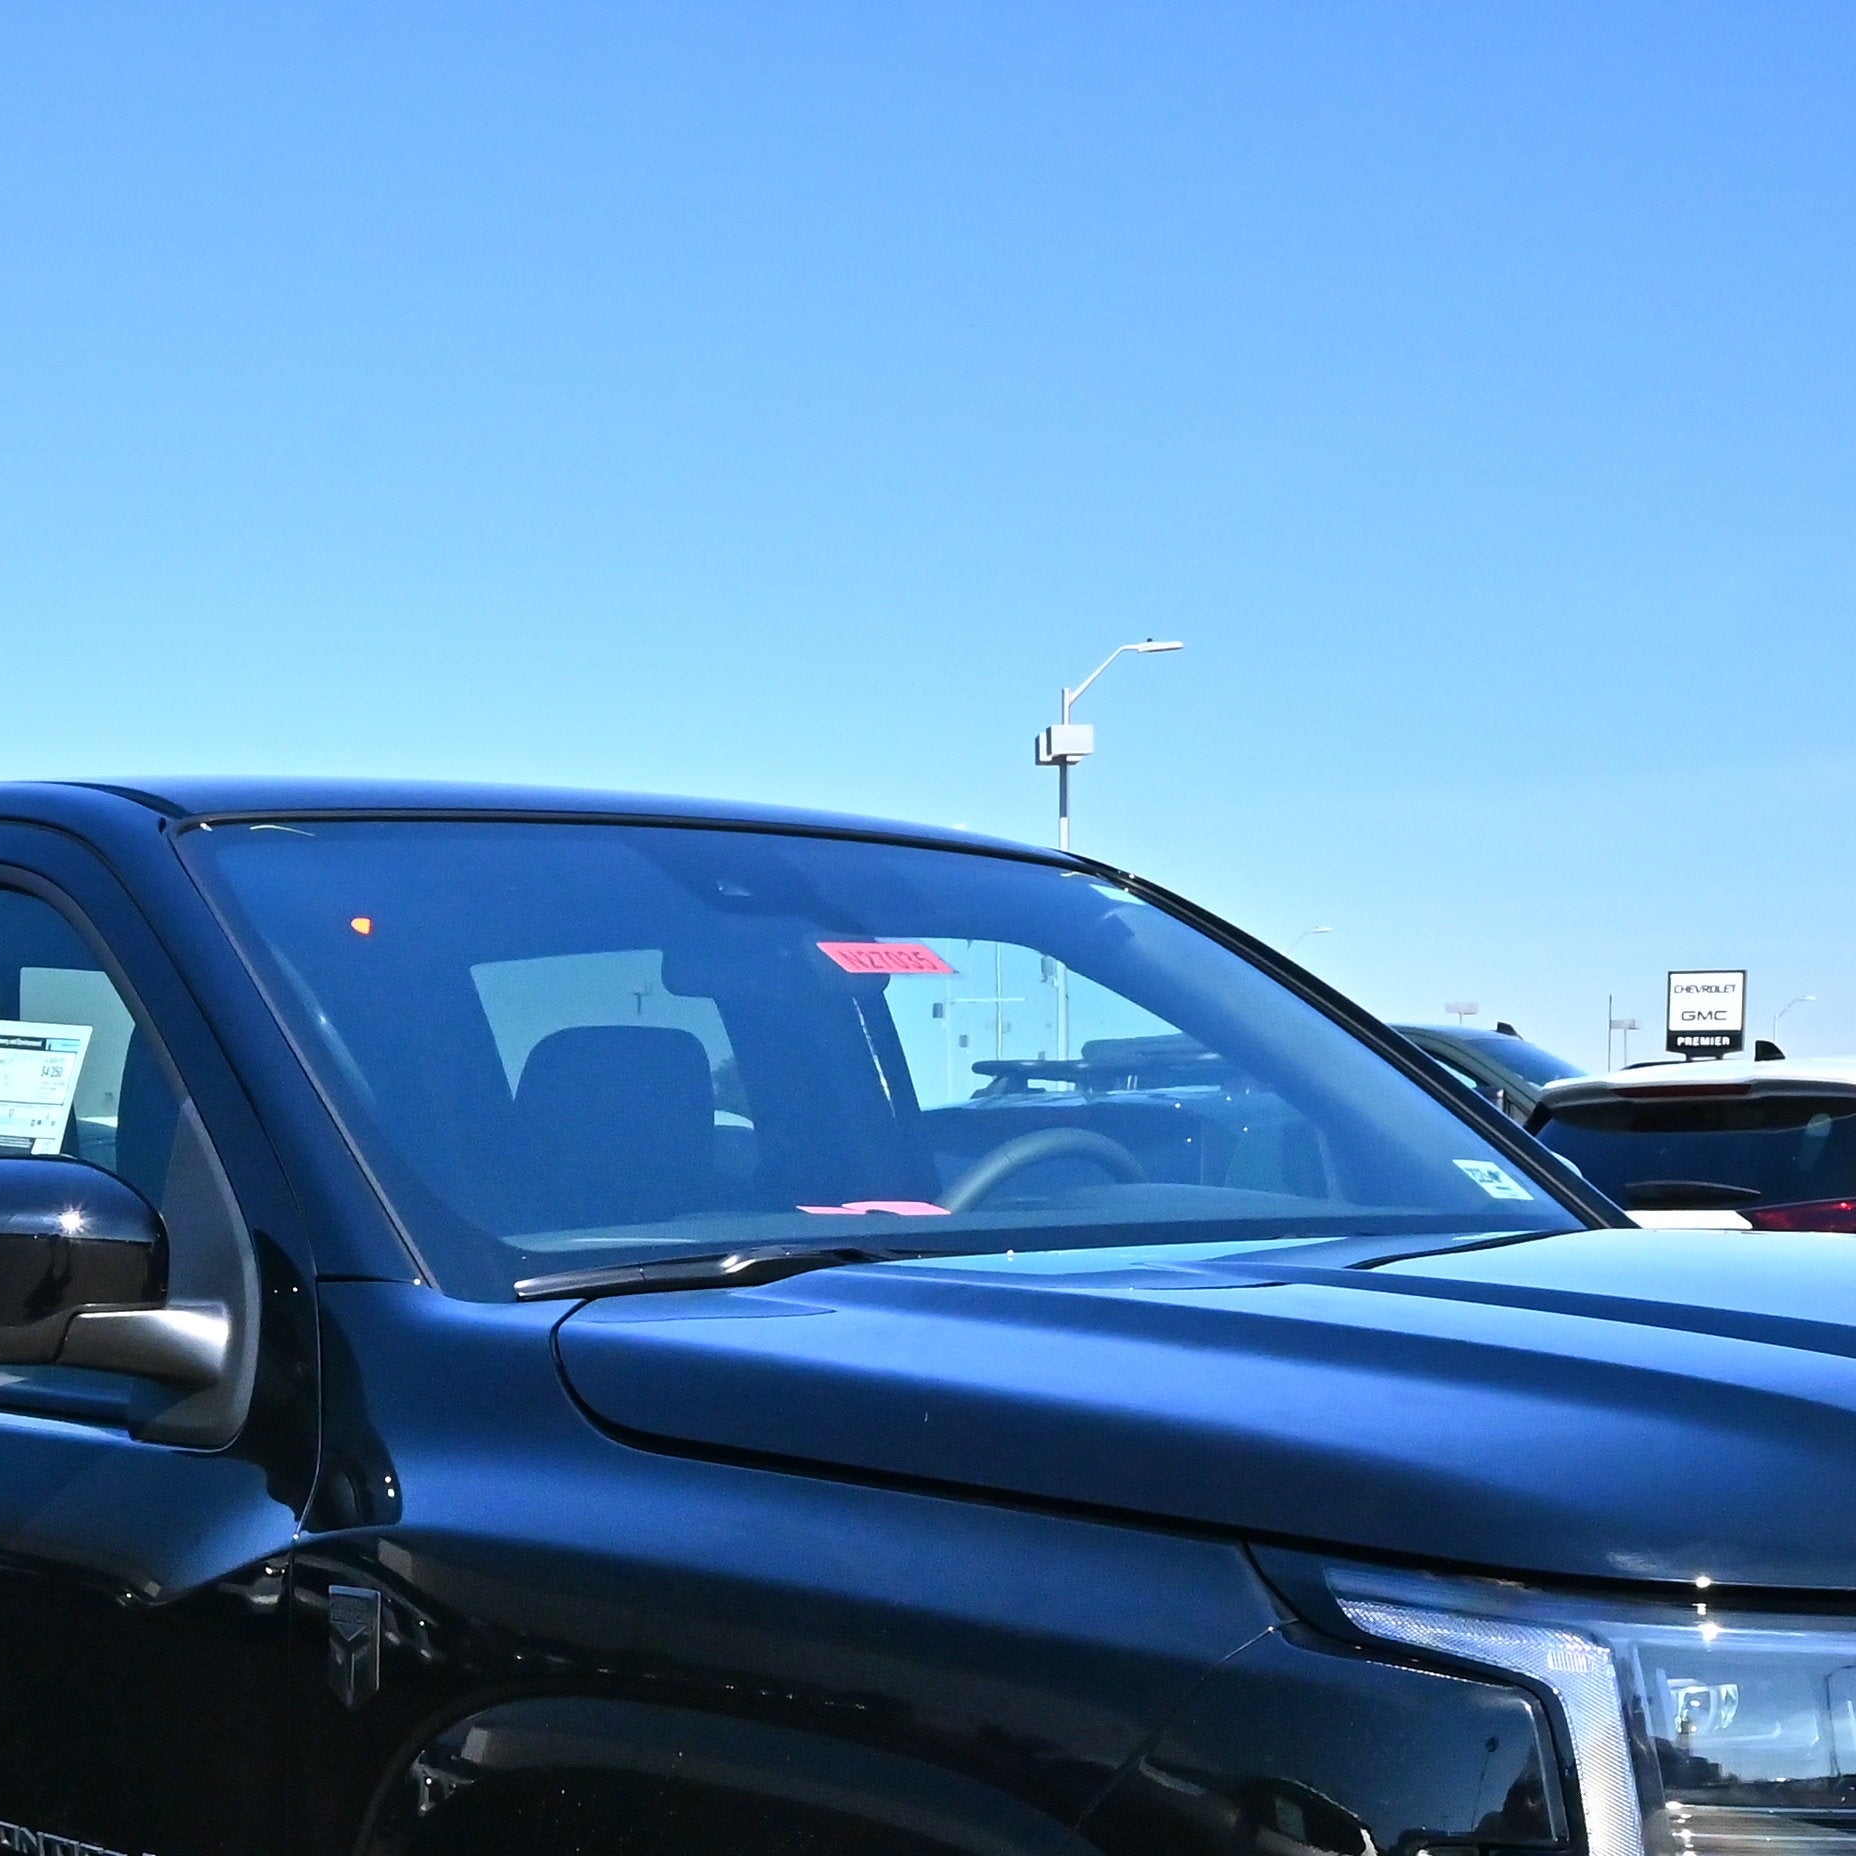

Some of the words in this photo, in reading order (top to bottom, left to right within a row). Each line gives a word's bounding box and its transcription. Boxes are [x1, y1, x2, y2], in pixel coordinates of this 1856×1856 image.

[837, 950, 938, 970] N27035
[1674, 984, 1736, 994] CHEVROLET
[1681, 1010, 1728, 1021] GMC
[1676, 1036, 1731, 1047] PREMIER
